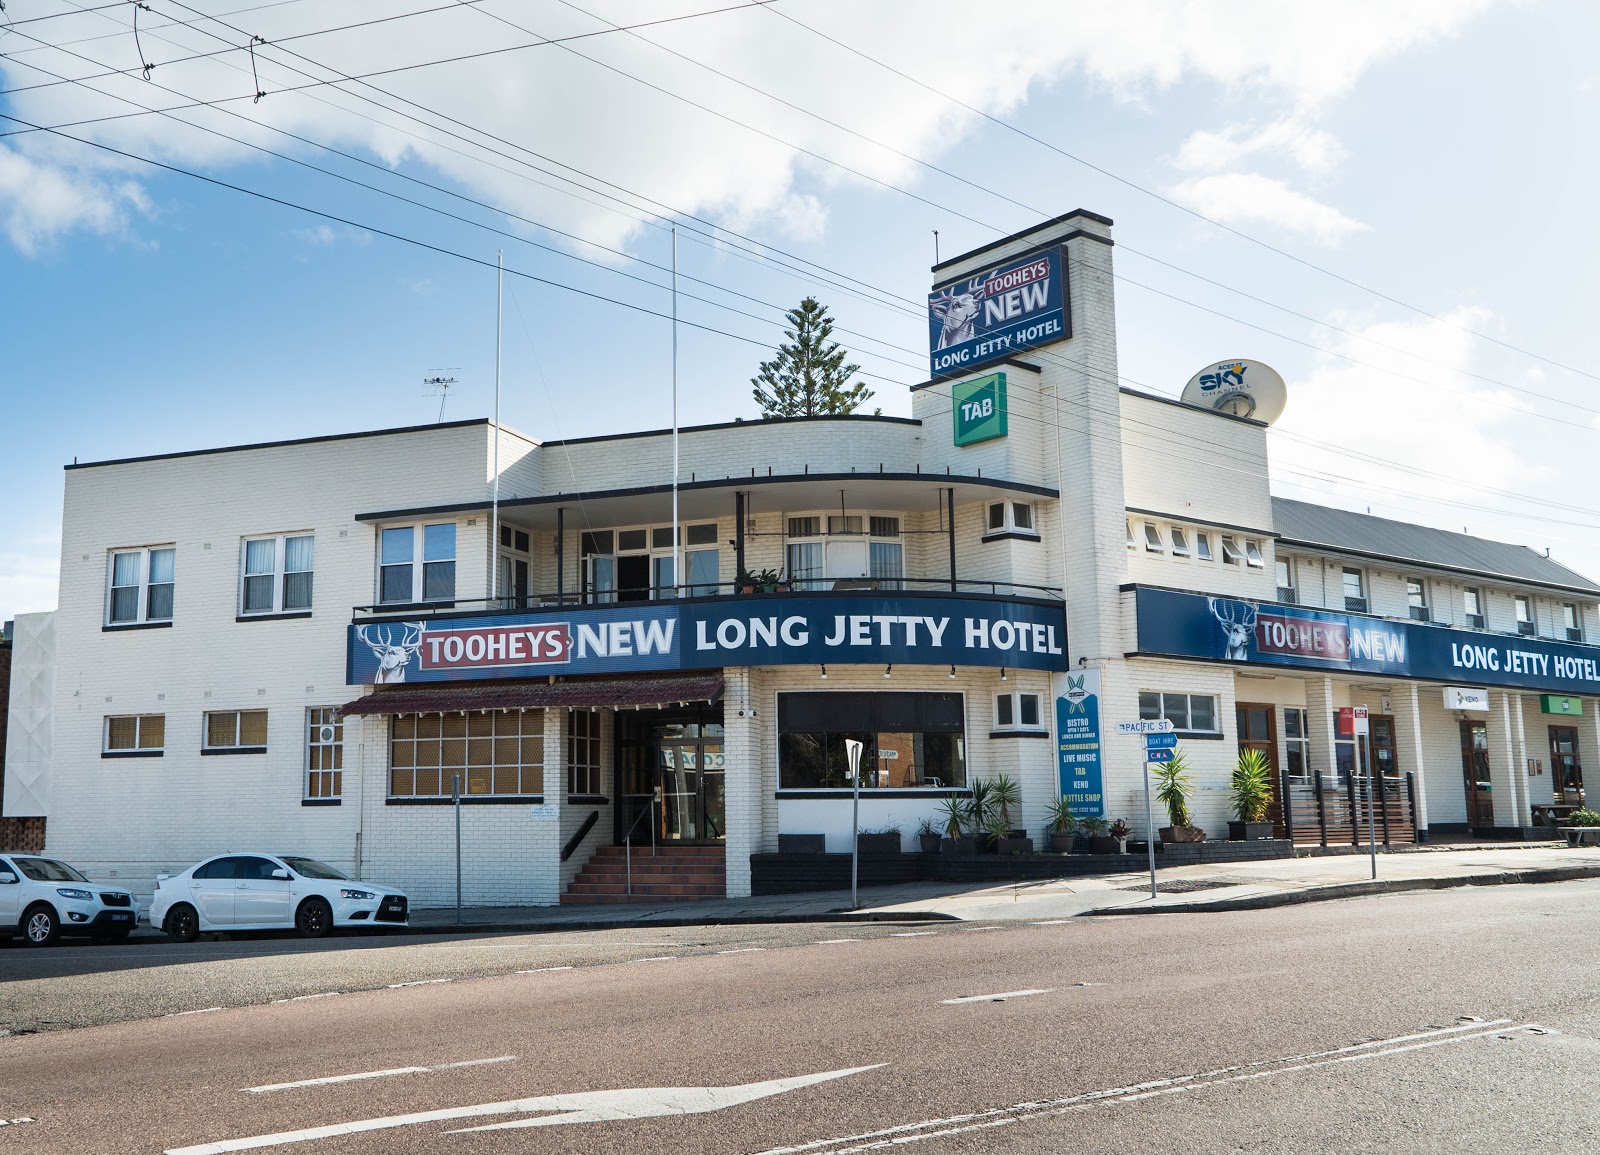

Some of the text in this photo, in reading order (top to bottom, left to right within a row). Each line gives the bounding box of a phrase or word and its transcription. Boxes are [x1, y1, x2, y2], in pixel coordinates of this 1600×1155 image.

[986, 261, 1046, 294] TOOHEYS
[984, 278, 1050, 327] NEW
[934, 318, 1061, 371] LONG JETTY HOTEL
[1199, 366, 1248, 391] SKY
[1202, 384, 1252, 397] CHANNEL
[961, 398, 993, 422] TAB
[427, 615, 1062, 663] TOOHEYS NEW LONG JETTY HOTEL
[1260, 620, 1600, 682] TOOHEYS NEW LONG JETTY HOTEL
[1465, 695, 1479, 703] KENO
[1067, 718, 1089, 727] BISTRO
[1125, 721, 1168, 732] PACIFIC ST
[1063, 753, 1096, 763] LIVE MUSIC
[1075, 767, 1086, 776] TAB
[1073, 781, 1089, 789] KENO
[1063, 793, 1101, 802] BOTTLE SHOP
